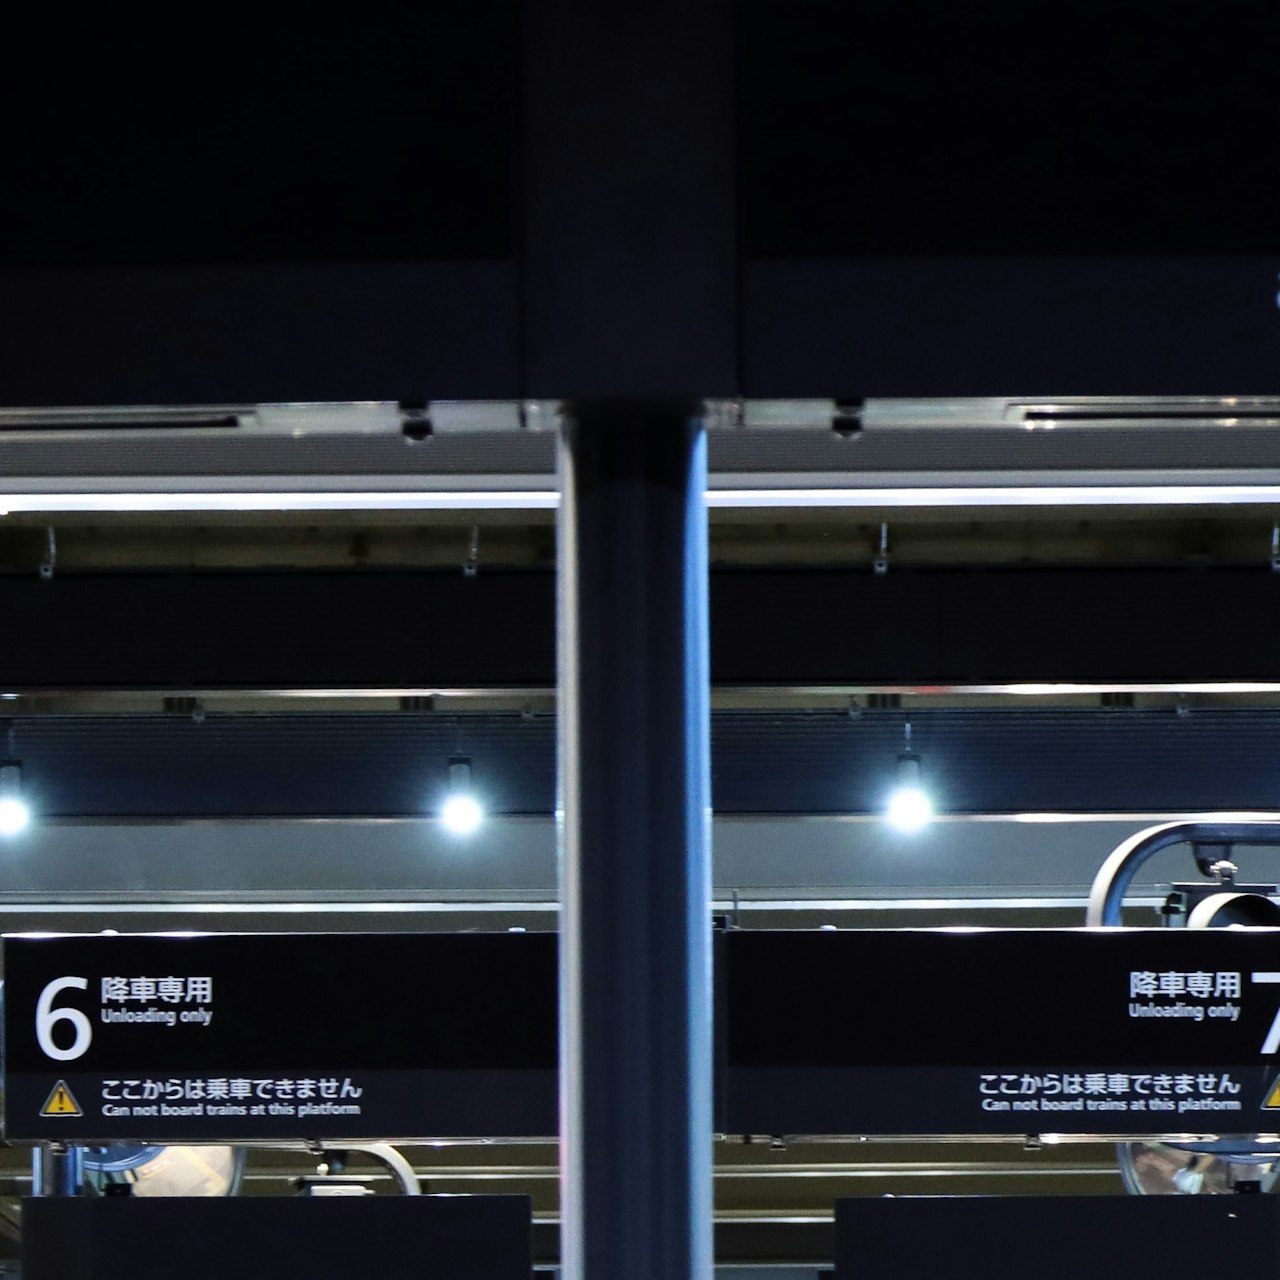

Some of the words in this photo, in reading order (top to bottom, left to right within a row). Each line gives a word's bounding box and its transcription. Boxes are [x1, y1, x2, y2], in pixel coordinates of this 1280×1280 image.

[101, 975, 213, 1004] 降車専用
[1130, 970, 1241, 999] 降車専用
[35, 976, 93, 1061] 6
[101, 1008, 177, 1026] Unloading
[180, 1008, 213, 1026] only
[1129, 1002, 1205, 1020] Unloading
[1208, 1002, 1241, 1021] only
[101, 1077, 363, 1100] ここからは乗車できません
[979, 1072, 1241, 1096] ここからは乗車できません
[101, 1104, 130, 1117] Can
[133, 1105, 159, 1116] not
[161, 1103, 204, 1116] board
[206, 1103, 247, 1116] trains
[250, 1104, 266, 1116] at
[268, 1103, 296, 1116] this
[298, 1102, 361, 1118] platform
[981, 1099, 1010, 1111] Can
[1013, 1100, 1039, 1111] not
[1041, 1098, 1084, 1111] board
[1086, 1098, 1127, 1111] trains
[1130, 1099, 1146, 1111] at
[1149, 1098, 1176, 1111] this
[1178, 1097, 1242, 1113] platform
